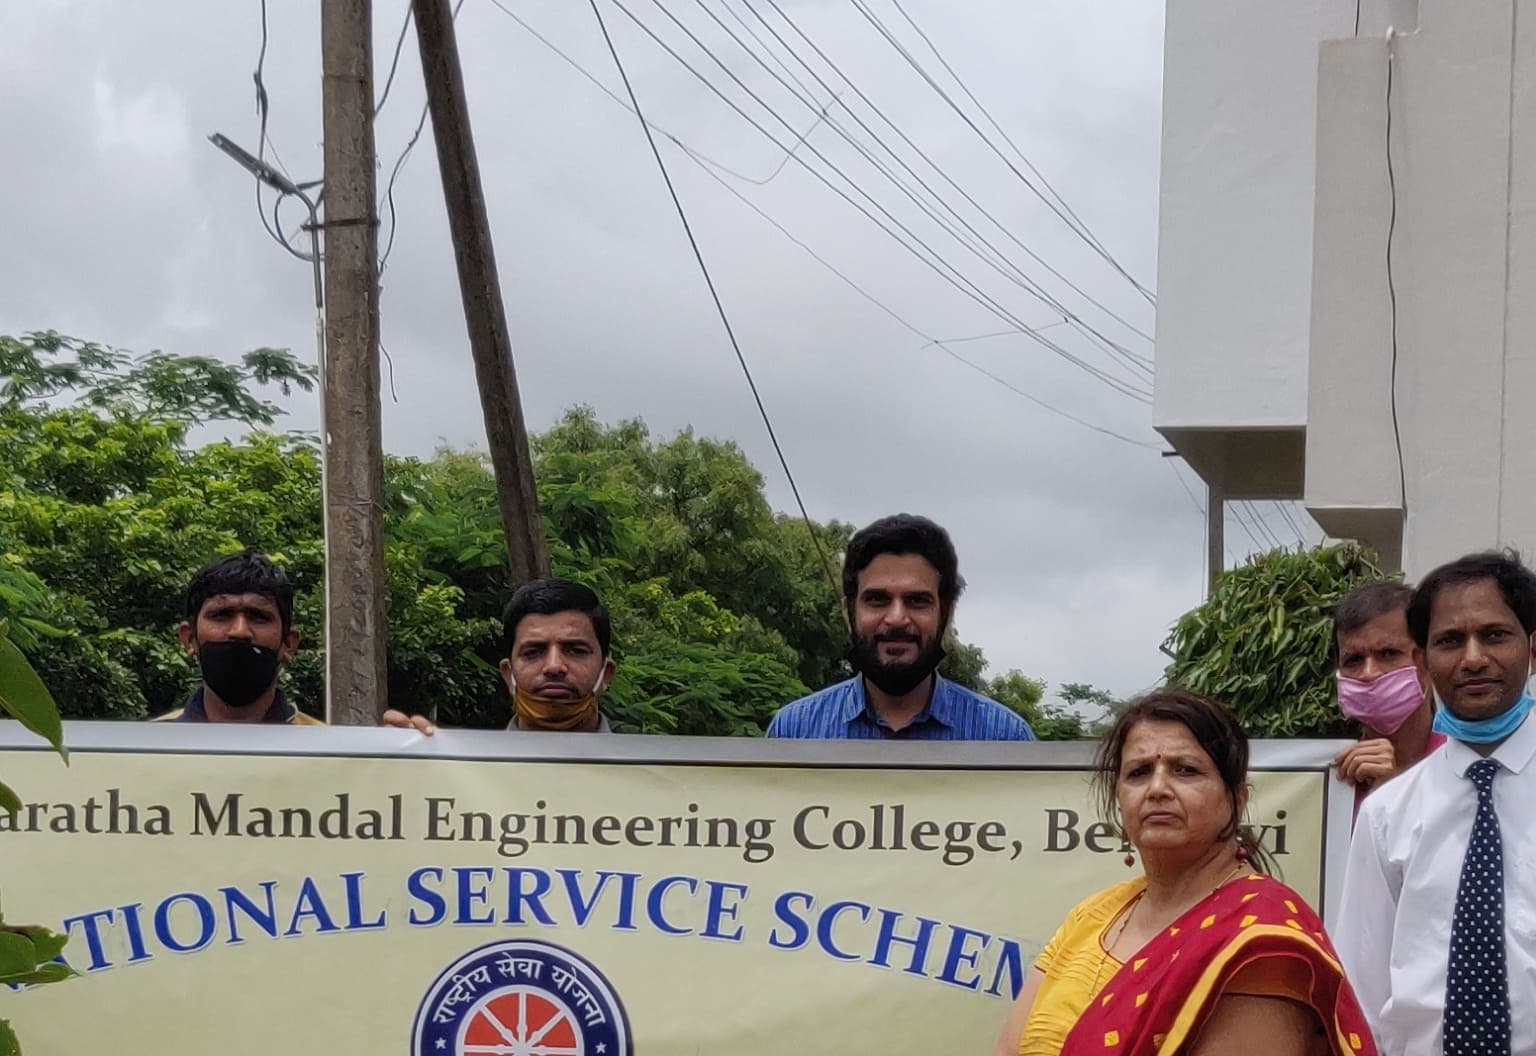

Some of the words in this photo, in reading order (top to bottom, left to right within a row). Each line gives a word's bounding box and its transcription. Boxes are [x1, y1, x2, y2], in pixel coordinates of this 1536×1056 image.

[190, 792, 406, 840] Mandal
[424, 797, 776, 864] Engineering
[793, 804, 1023, 866] College,
[4, 872, 387, 991] TIONAL
[407, 866, 749, 942] SERVICE
[768, 890, 1025, 1001] SCHE
[432, 964, 492, 1024] राष्ट्रीय
[495, 952, 544, 979] सेवा
[552, 965, 606, 1027] योजना
